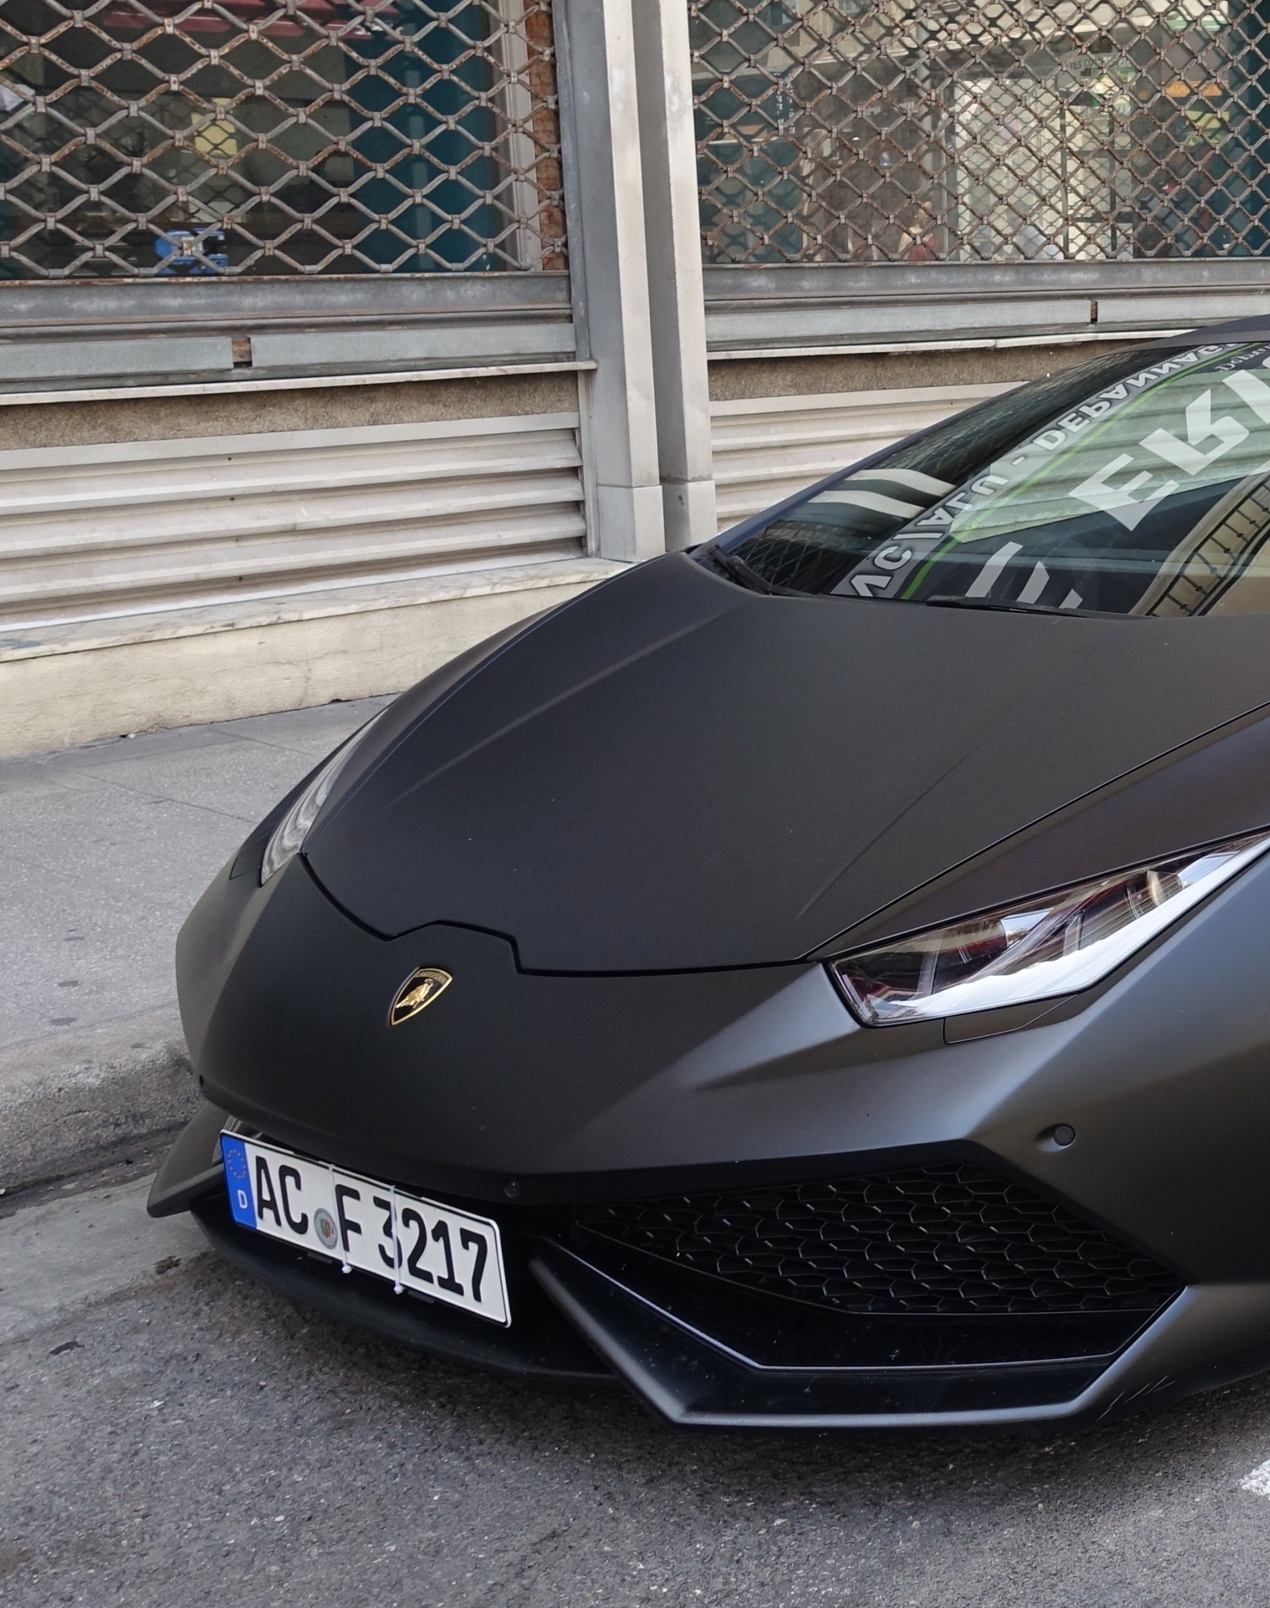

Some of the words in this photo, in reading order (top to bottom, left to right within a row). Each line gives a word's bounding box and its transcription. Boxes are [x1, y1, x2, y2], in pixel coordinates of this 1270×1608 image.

[237, 1189, 249, 1210] D
[255, 1155, 309, 1235] AC
[335, 1183, 362, 1253] F
[372, 1196, 489, 1304] 3217
